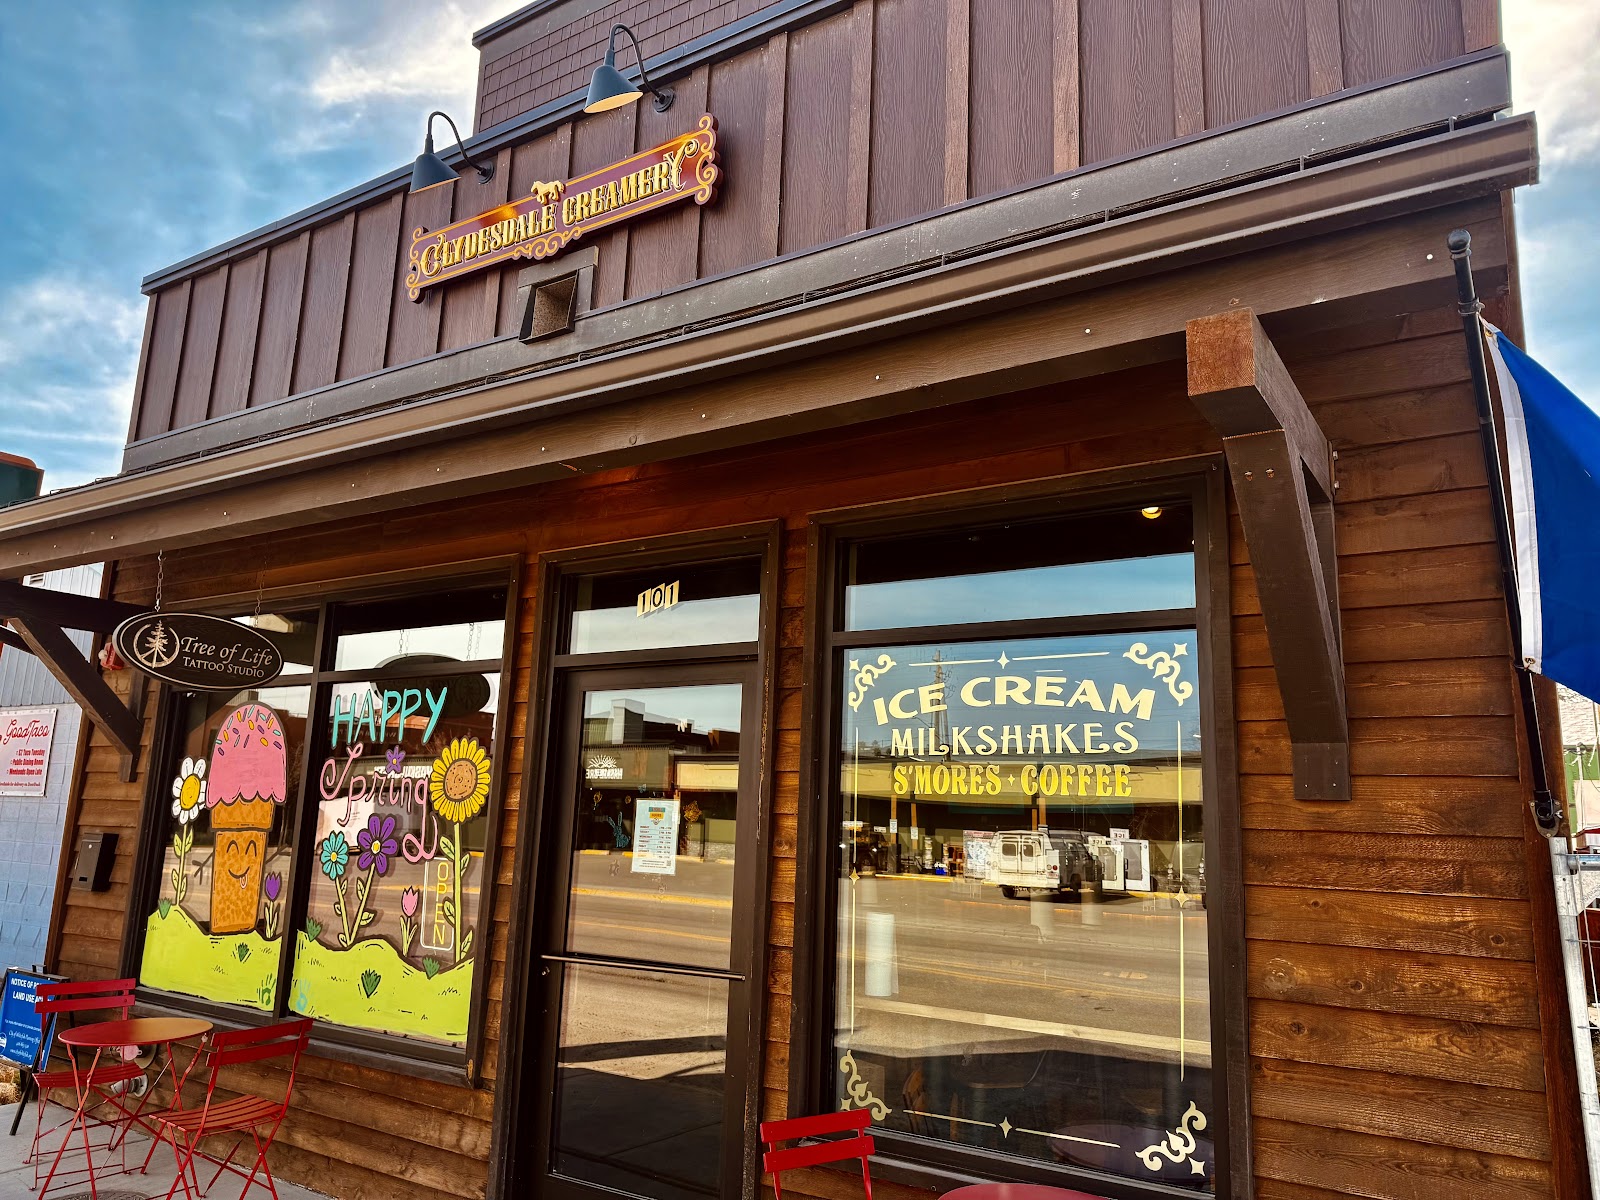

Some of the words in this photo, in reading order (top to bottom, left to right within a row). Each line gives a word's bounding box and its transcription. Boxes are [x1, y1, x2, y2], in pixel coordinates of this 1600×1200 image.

[419, 203, 557, 277] CLYDESDALE
[562, 139, 699, 227] CREAMERY
[640, 583, 676, 614] 101
[181, 637, 216, 654] Tree
[220, 643, 242, 664] of
[239, 646, 273, 669] Life
[183, 656, 225, 672] TATTOO
[227, 664, 265, 679] STUDIO
[331, 686, 448, 749] HAPPY
[872, 682, 948, 726] ICE
[960, 676, 1156, 721] CREAM
[890, 722, 1140, 757] MILKSHAKES
[893, 764, 1001, 796] S'MORES
[1020, 764, 1132, 797] COFFEE
[319, 742, 438, 863] Spring
[433, 862, 450, 946] OPEN
[11, 978, 27, 988] NOTICE
[27, 981, 34, 989] OF
[12, 991, 25, 1000] LAND
[25, 993, 34, 1003] USE
